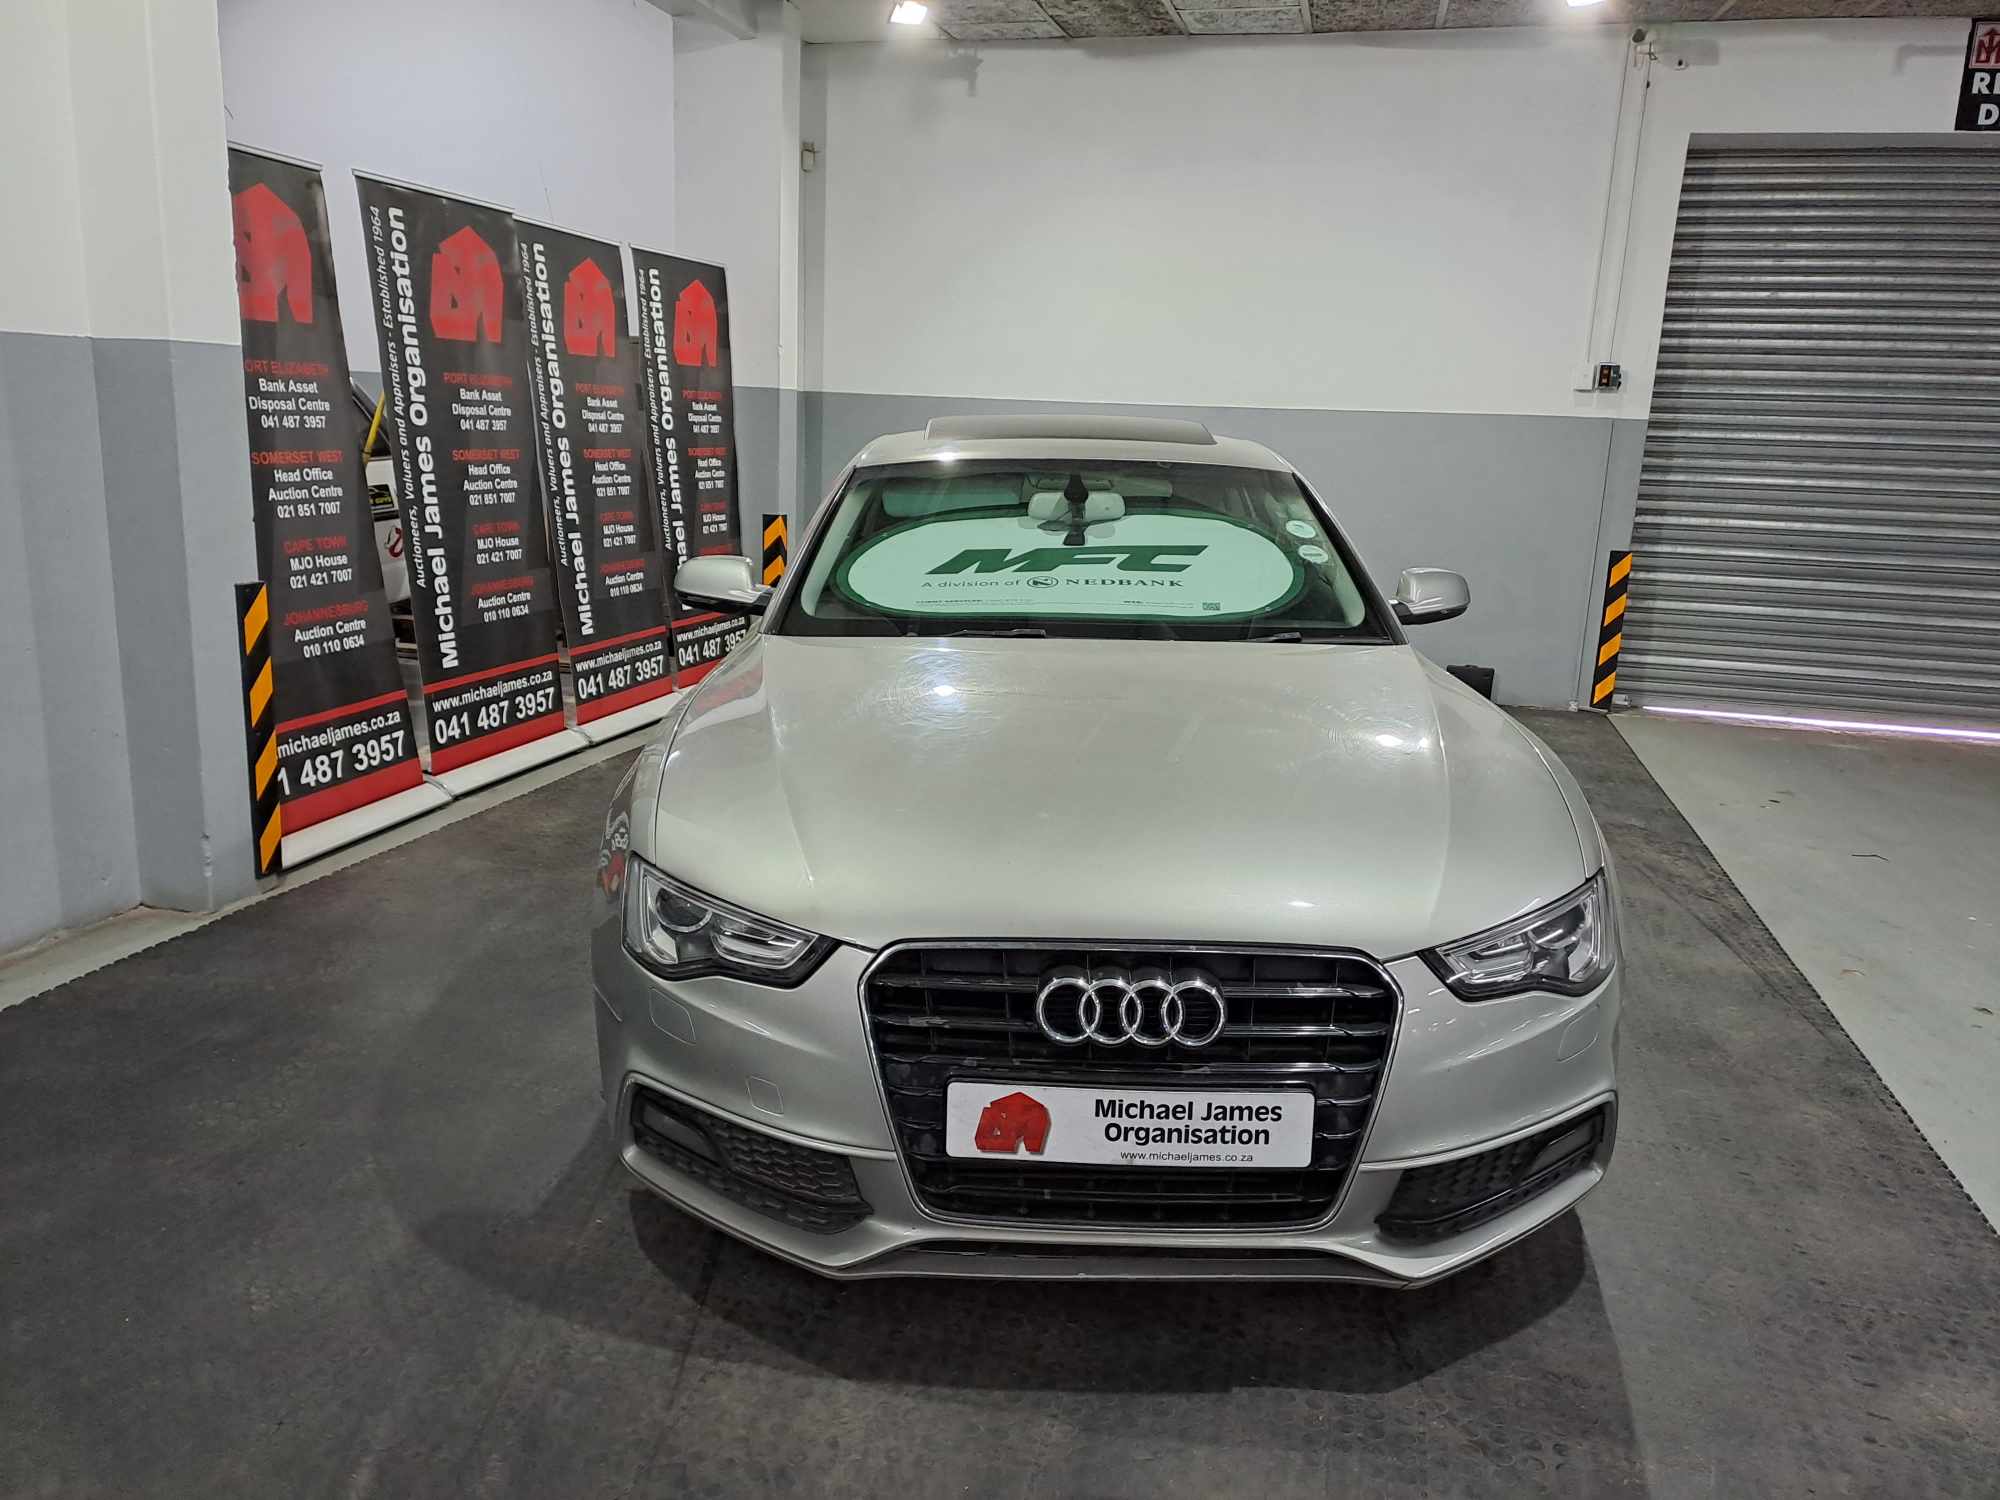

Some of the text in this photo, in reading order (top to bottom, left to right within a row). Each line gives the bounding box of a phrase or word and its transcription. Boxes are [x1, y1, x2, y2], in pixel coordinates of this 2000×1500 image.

[523, 275, 539, 346] Established
[648, 268, 674, 431] Organisation
[258, 378, 319, 393] Bank Asset
[369, 205, 427, 589] Auctioneers, Valuers and Appraisers Established 1964
[459, 388, 503, 402] Bank Asset
[534, 356, 549, 420] Appraisers
[248, 396, 331, 413] Disposal Centre
[451, 403, 512, 417] Disposal Centre
[261, 414, 326, 429] 041 487 3957
[460, 418, 507, 431] 041 487 3957
[540, 420, 552, 446] and
[388, 207, 460, 669] Michael James Organisation
[533, 242, 594, 636] Michael James Organisation
[650, 423, 661, 445] and
[274, 467, 333, 482] Head Office
[468, 463, 511, 476] Head Office
[546, 447, 558, 492] Valuers
[654, 447, 664, 485] Valuers
[665, 437, 683, 514] James
[268, 485, 343, 501] Auction Centre
[463, 478, 518, 491] Auction Centre
[277, 501, 341, 518] 021 851 7007
[469, 492, 515, 506] 021 851 7007
[477, 536, 519, 550] MJO House
[290, 553, 348, 572] MJO House
[476, 548, 522, 565] 021 421 7007
[924, 545, 1208, 575] MFC
[289, 569, 353, 590] 021 421 7007
[605, 574, 626, 585] Auction
[937, 578, 999, 588] division
[1004, 579, 1020, 587] of
[1066, 578, 1184, 588] NEDBANK
[478, 591, 531, 609] Auction Centre
[483, 610, 497, 623] 010
[498, 607, 511, 620] 110
[294, 618, 367, 643] Auction Centre
[676, 616, 745, 642] www.michaeljames.co.za
[303, 634, 365, 658] 010 110 0634
[575, 640, 662, 672] www.michaeljames.co.za
[678, 643, 700, 666] 041
[702, 637, 720, 658] 487
[577, 655, 664, 699] 041 487 3957
[432, 670, 553, 713] www.michaeljames.co.za
[434, 686, 555, 745] 041 487 3957
[277, 711, 401, 760] michaeljames.co.za
[300, 749, 344, 788] 487
[351, 729, 405, 772] 3957
[1094, 1098, 1282, 1122] Michael James
[1104, 1122, 1270, 1147] Organisation
[1120, 1151, 1253, 1164] www.michaeljames.co.za
